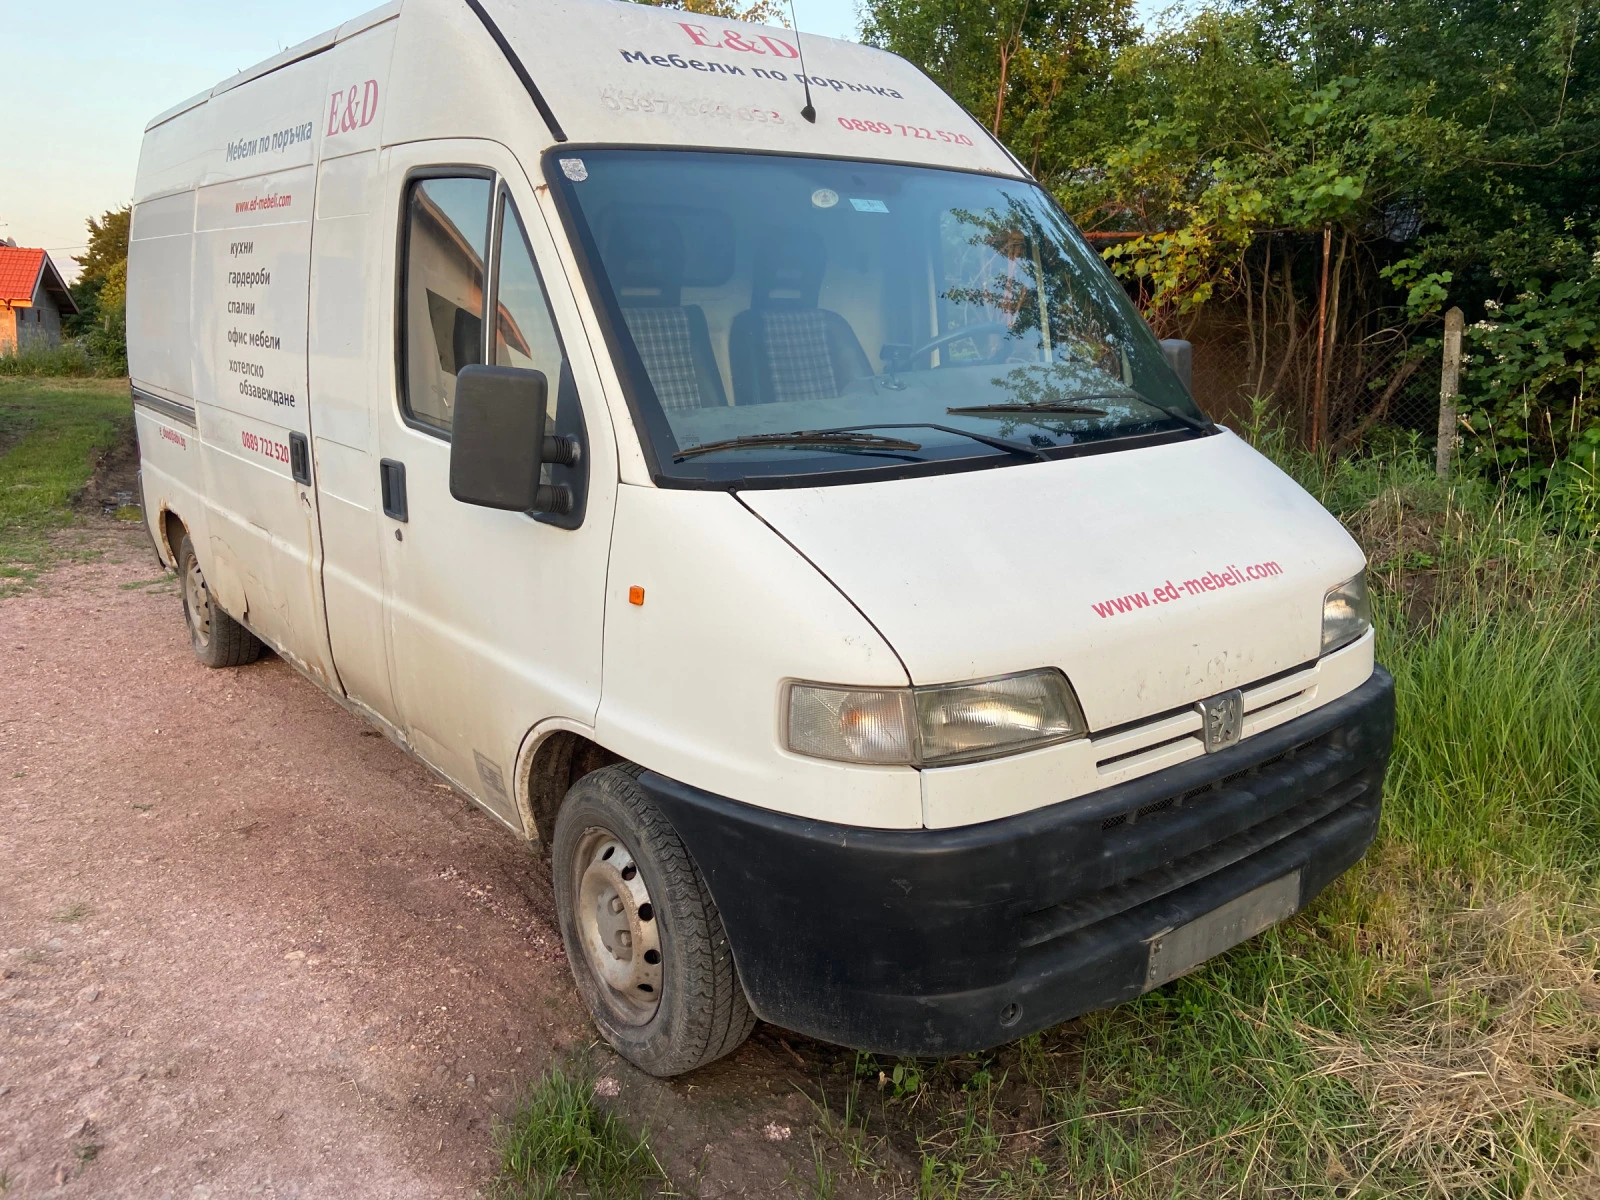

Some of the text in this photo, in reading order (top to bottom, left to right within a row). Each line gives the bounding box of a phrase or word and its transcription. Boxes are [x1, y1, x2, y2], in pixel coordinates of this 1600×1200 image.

[672, 22, 799, 58] E&D
[619, 48, 904, 99] Мебели по поръчка
[326, 79, 378, 136] E&D
[226, 121, 313, 163] Мебели по поръчка
[837, 117, 974, 147] 0889 722 520
[235, 193, 292, 213] www.ed-mebeli.com
[230, 241, 254, 258] кухни
[228, 267, 270, 288] гардероби
[227, 300, 255, 315] спални
[227, 327, 280, 350] офис мебели
[229, 359, 264, 379] хотелско
[239, 379, 295, 407] обзавеждане
[241, 430, 290, 463] 0889 722 520
[1091, 560, 1284, 619] www.ed-mebeli.com
